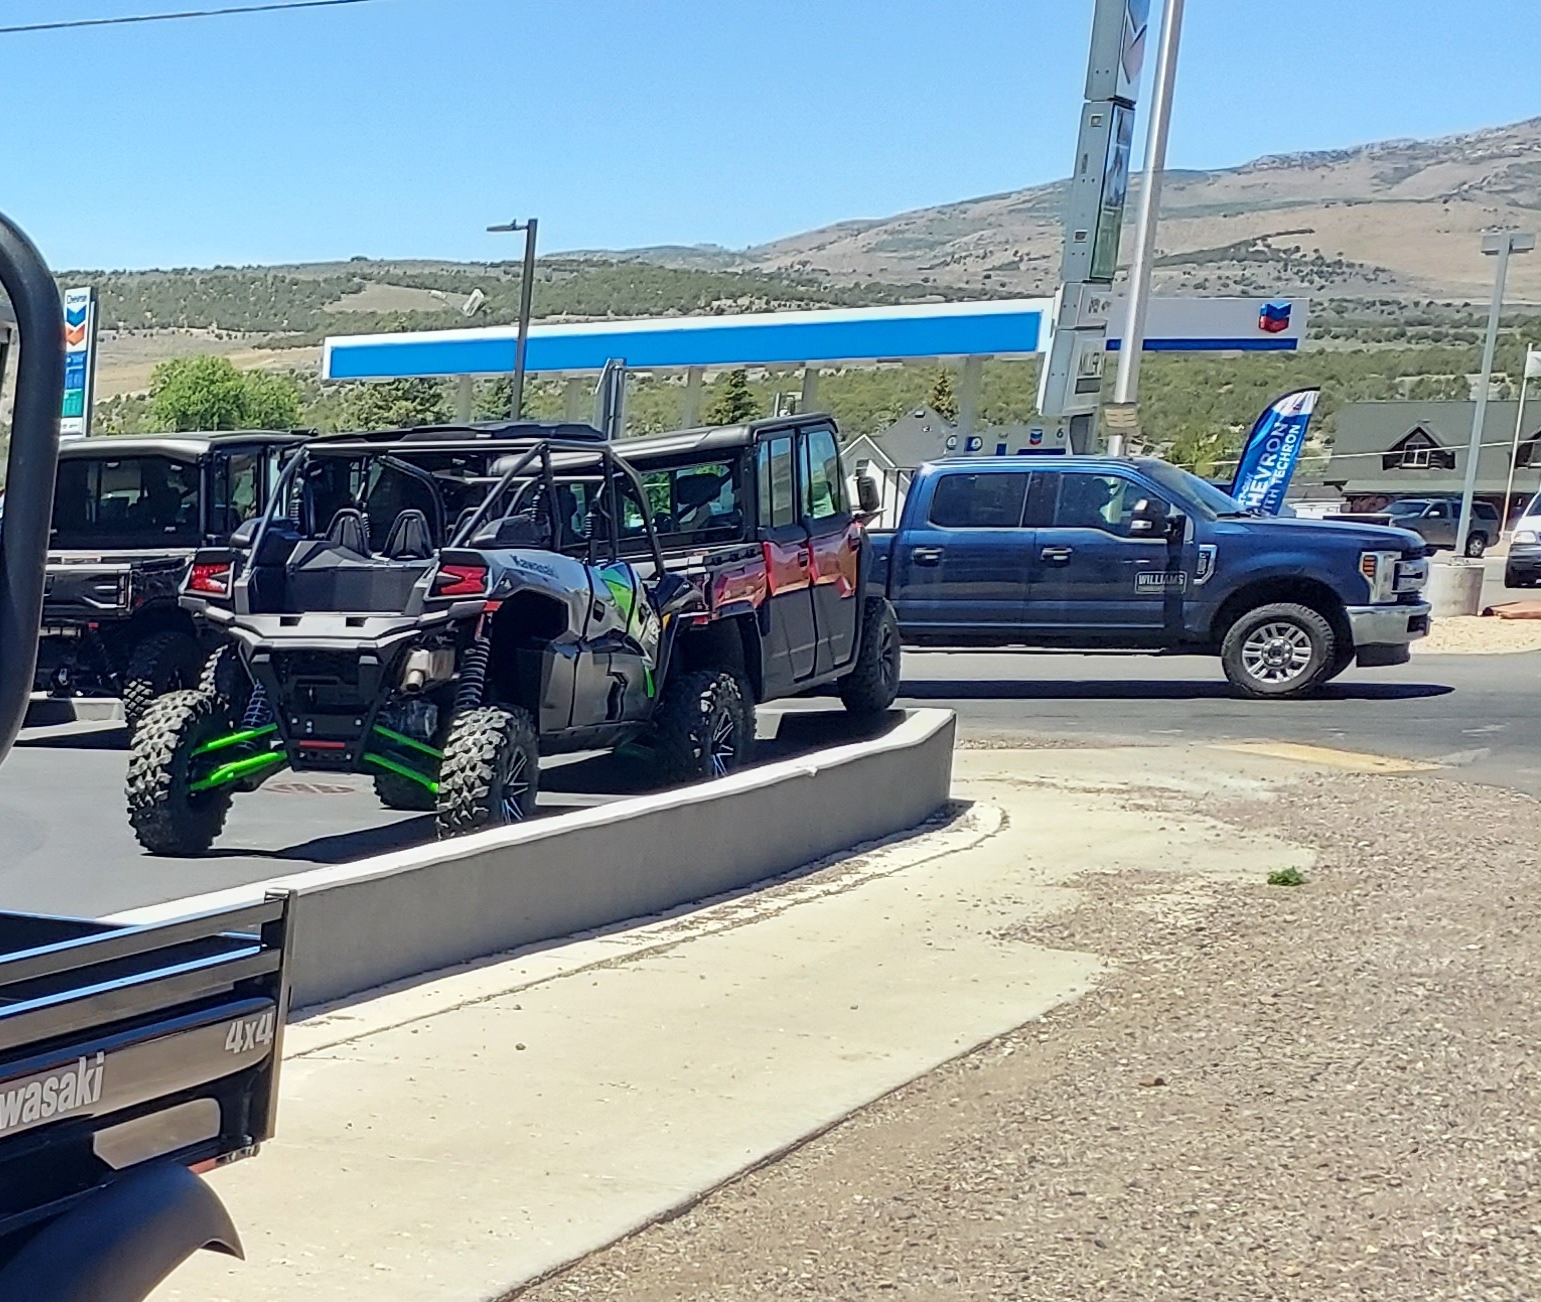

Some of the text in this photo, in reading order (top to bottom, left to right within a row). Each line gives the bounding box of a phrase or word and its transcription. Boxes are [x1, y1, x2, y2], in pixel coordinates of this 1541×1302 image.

[1245, 420, 1289, 508] HEVRON
[1271, 424, 1301, 484] TECHRON
[1138, 574, 1185, 586] WILLIAMS
[225, 1013, 275, 1054] 4x4
